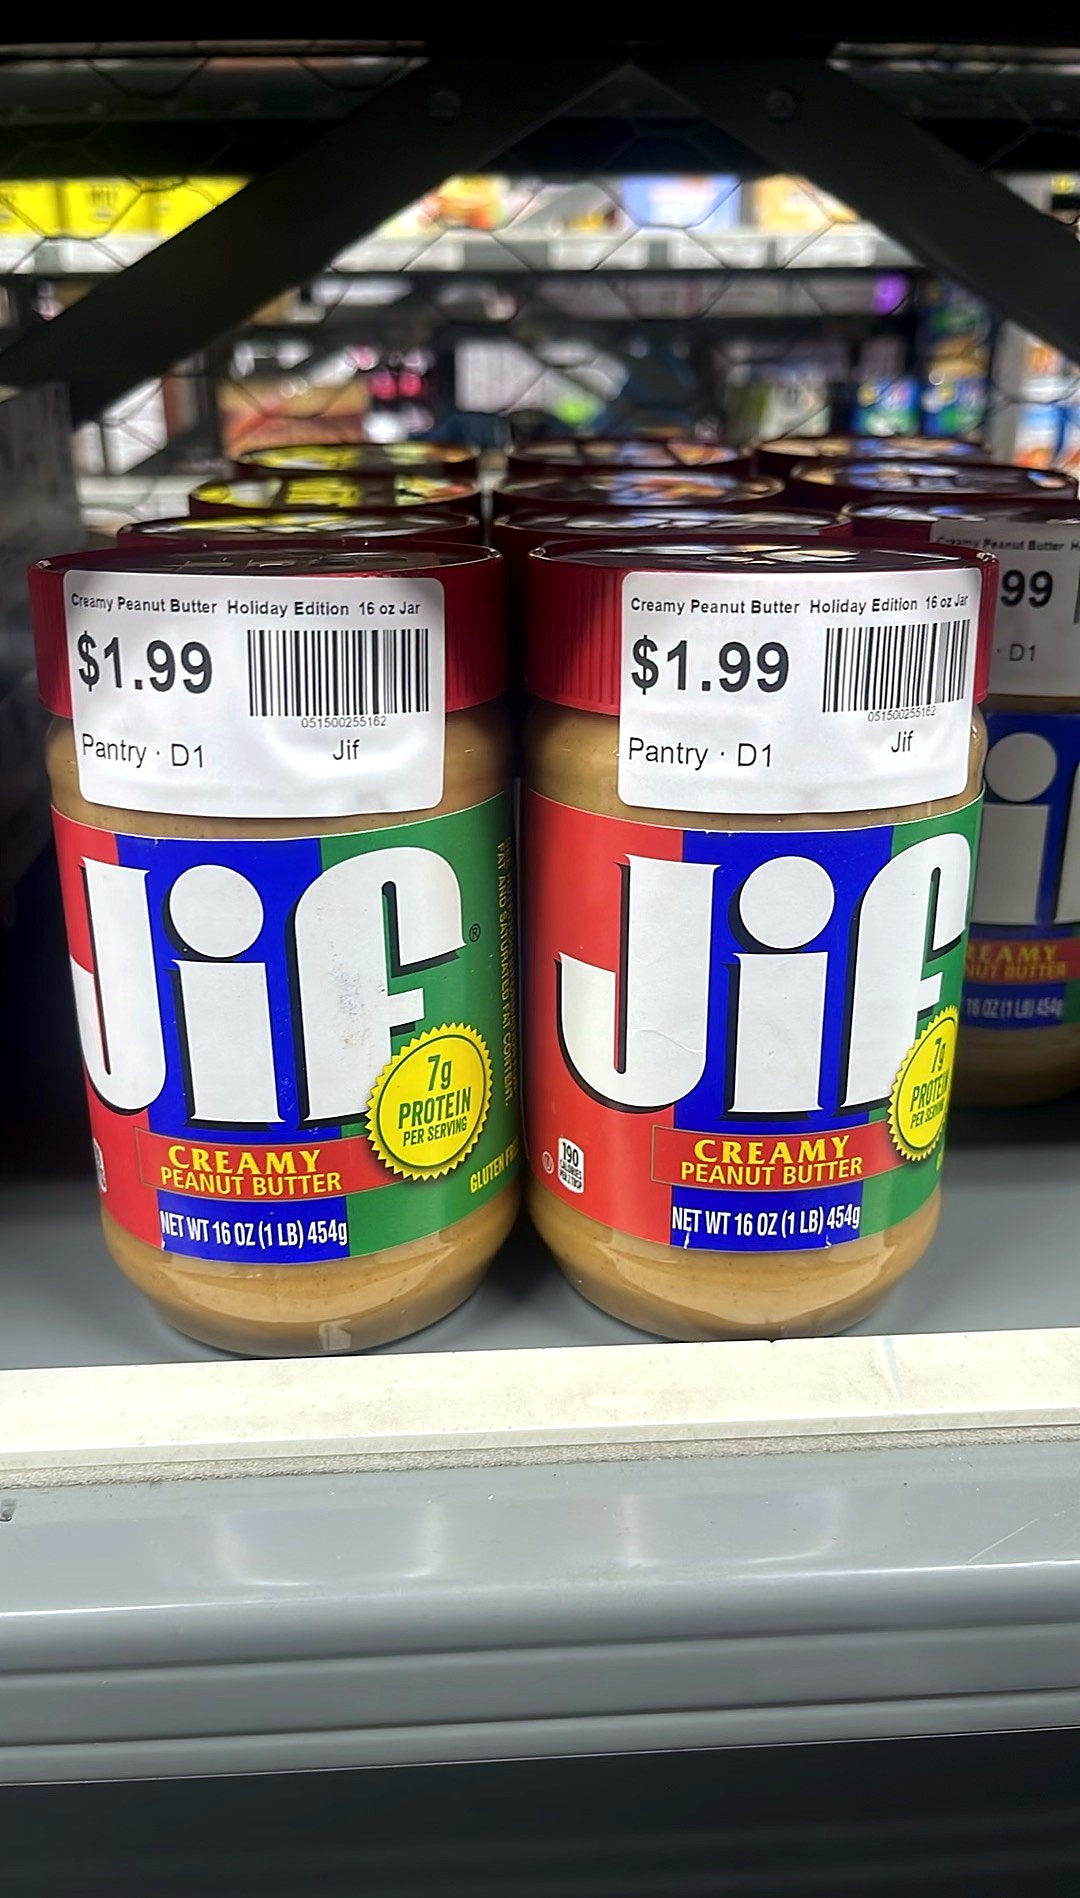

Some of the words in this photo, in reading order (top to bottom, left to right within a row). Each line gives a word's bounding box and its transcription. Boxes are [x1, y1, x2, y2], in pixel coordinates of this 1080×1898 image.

[1028, 541, 1065, 551] Butter
[1000, 570, 1053, 608] 99
[72, 592, 113, 611] Creamy
[118, 597, 165, 613] Peanut
[170, 599, 217, 615] Butter
[227, 600, 288, 618] Holiday
[294, 601, 349, 616] Edition
[359, 602, 375, 615] 16
[379, 605, 395, 615] oz
[399, 602, 421, 615] Jar
[631, 598, 685, 616] Creamy
[691, 599, 746, 614] Peanut
[751, 599, 799, 615] Butter
[810, 598, 866, 615] Holiday
[872, 598, 918, 612] Edition
[926, 596, 937, 608] 16
[940, 598, 952, 607] oz
[955, 594, 968, 607] Jar
[77, 630, 213, 694] $1.99
[631, 635, 789, 694] $1.99
[1009, 643, 1036, 661] D1
[301, 716, 387, 729] 051500255162
[868, 705, 936, 722] 051500255162
[82, 733, 147, 768] Pantry
[171, 743, 204, 768] D1
[333, 740, 360, 761] Jif
[628, 737, 708, 771] Pantry
[738, 743, 772, 768] D1
[891, 731, 914, 754] Jif
[71, 846, 467, 1123] Jif
[557, 832, 971, 1115] Jif
[931, 1037, 946, 1073] 7g
[427, 1055, 452, 1092] 7g
[398, 1086, 471, 1129] PROTEIN
[911, 1110, 923, 1129] PER
[403, 1127, 425, 1146] PER
[429, 1115, 468, 1143] SERVING
[168, 1145, 322, 1176] CREAMY
[562, 1141, 579, 1168] 190
[693, 1135, 850, 1165] CREAMY
[161, 1166, 246, 1196] PEANUT
[252, 1170, 342, 1196] BUTTER
[470, 1153, 505, 1193] GLUTEN
[680, 1161, 776, 1186] PEANUT
[783, 1156, 863, 1185] BUTTER
[159, 1210, 184, 1238] NET
[187, 1217, 209, 1242] WT
[213, 1222, 230, 1244] 16
[234, 1224, 256, 1246] OZ
[259, 1222, 274, 1250] (1
[279, 1222, 304, 1249] LB)
[307, 1219, 348, 1246] 454g
[672, 1205, 702, 1233] NET
[705, 1209, 731, 1233] WT
[735, 1211, 753, 1235] 16
[757, 1211, 777, 1235] OZ
[781, 1209, 795, 1239] (1
[800, 1205, 823, 1237] LB)
[827, 1203, 860, 1233] 454g
